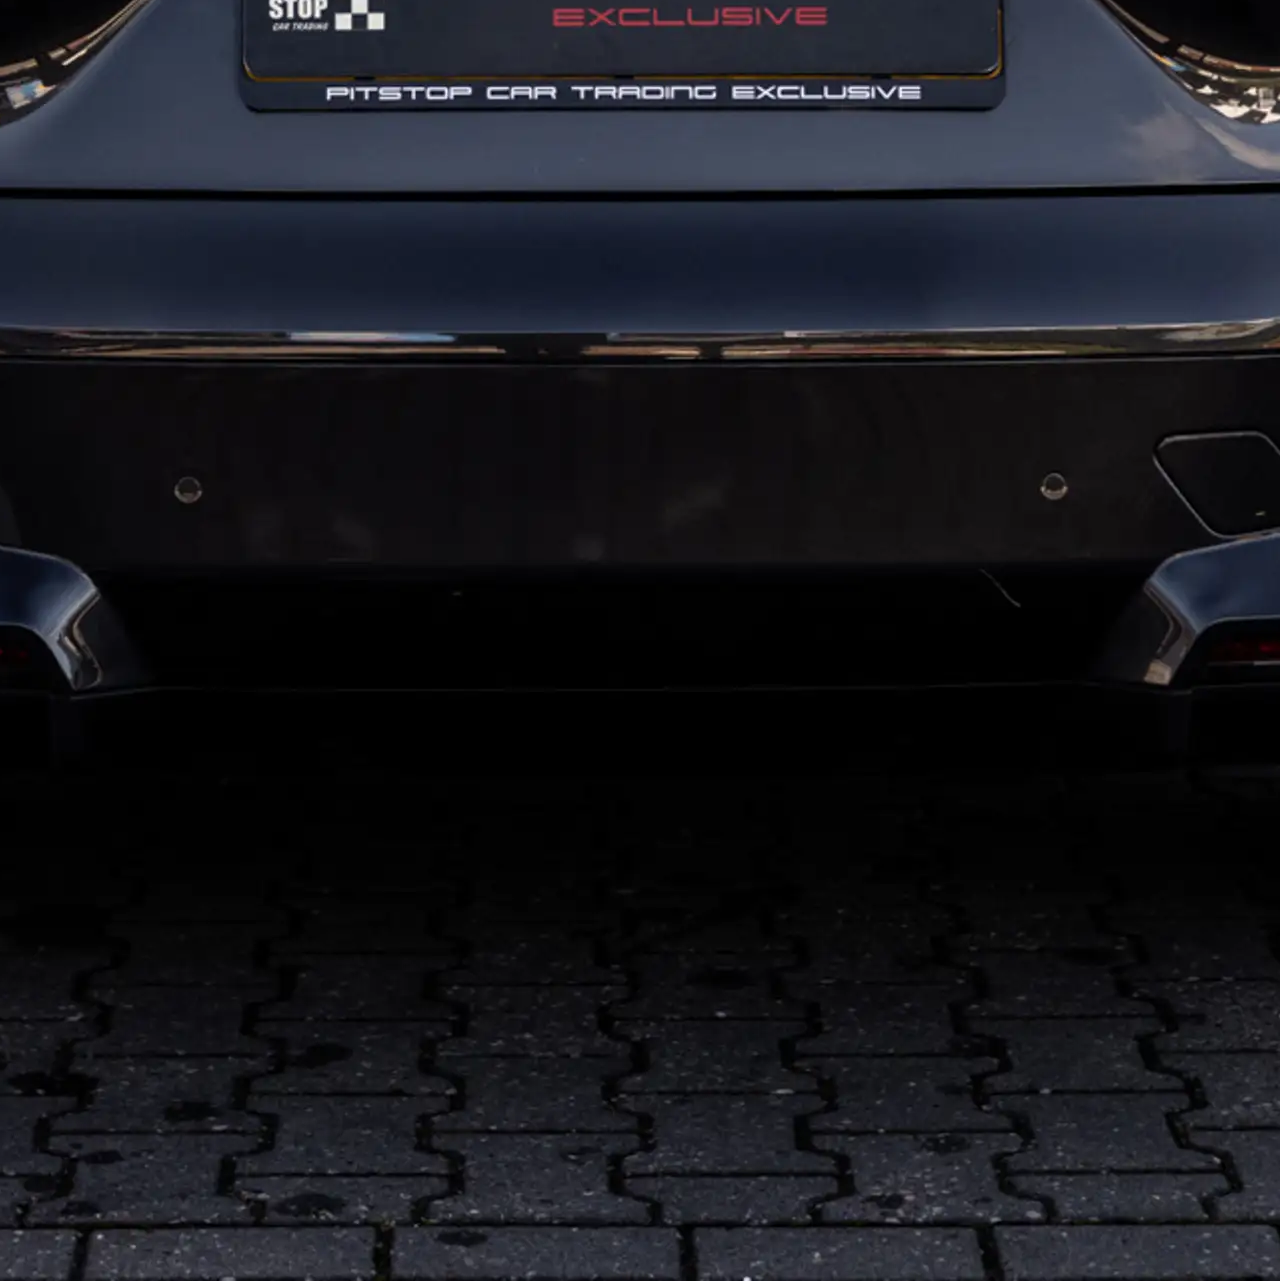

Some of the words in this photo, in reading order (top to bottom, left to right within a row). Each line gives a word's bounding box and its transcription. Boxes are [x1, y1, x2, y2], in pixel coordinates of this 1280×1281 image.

[552, 7, 828, 26] EXCLUSIVE
[326, 86, 472, 100] PITSTOP
[486, 86, 557, 100] CAR
[571, 85, 717, 100] TRADING
[732, 85, 921, 99] EXCLUSIVE
